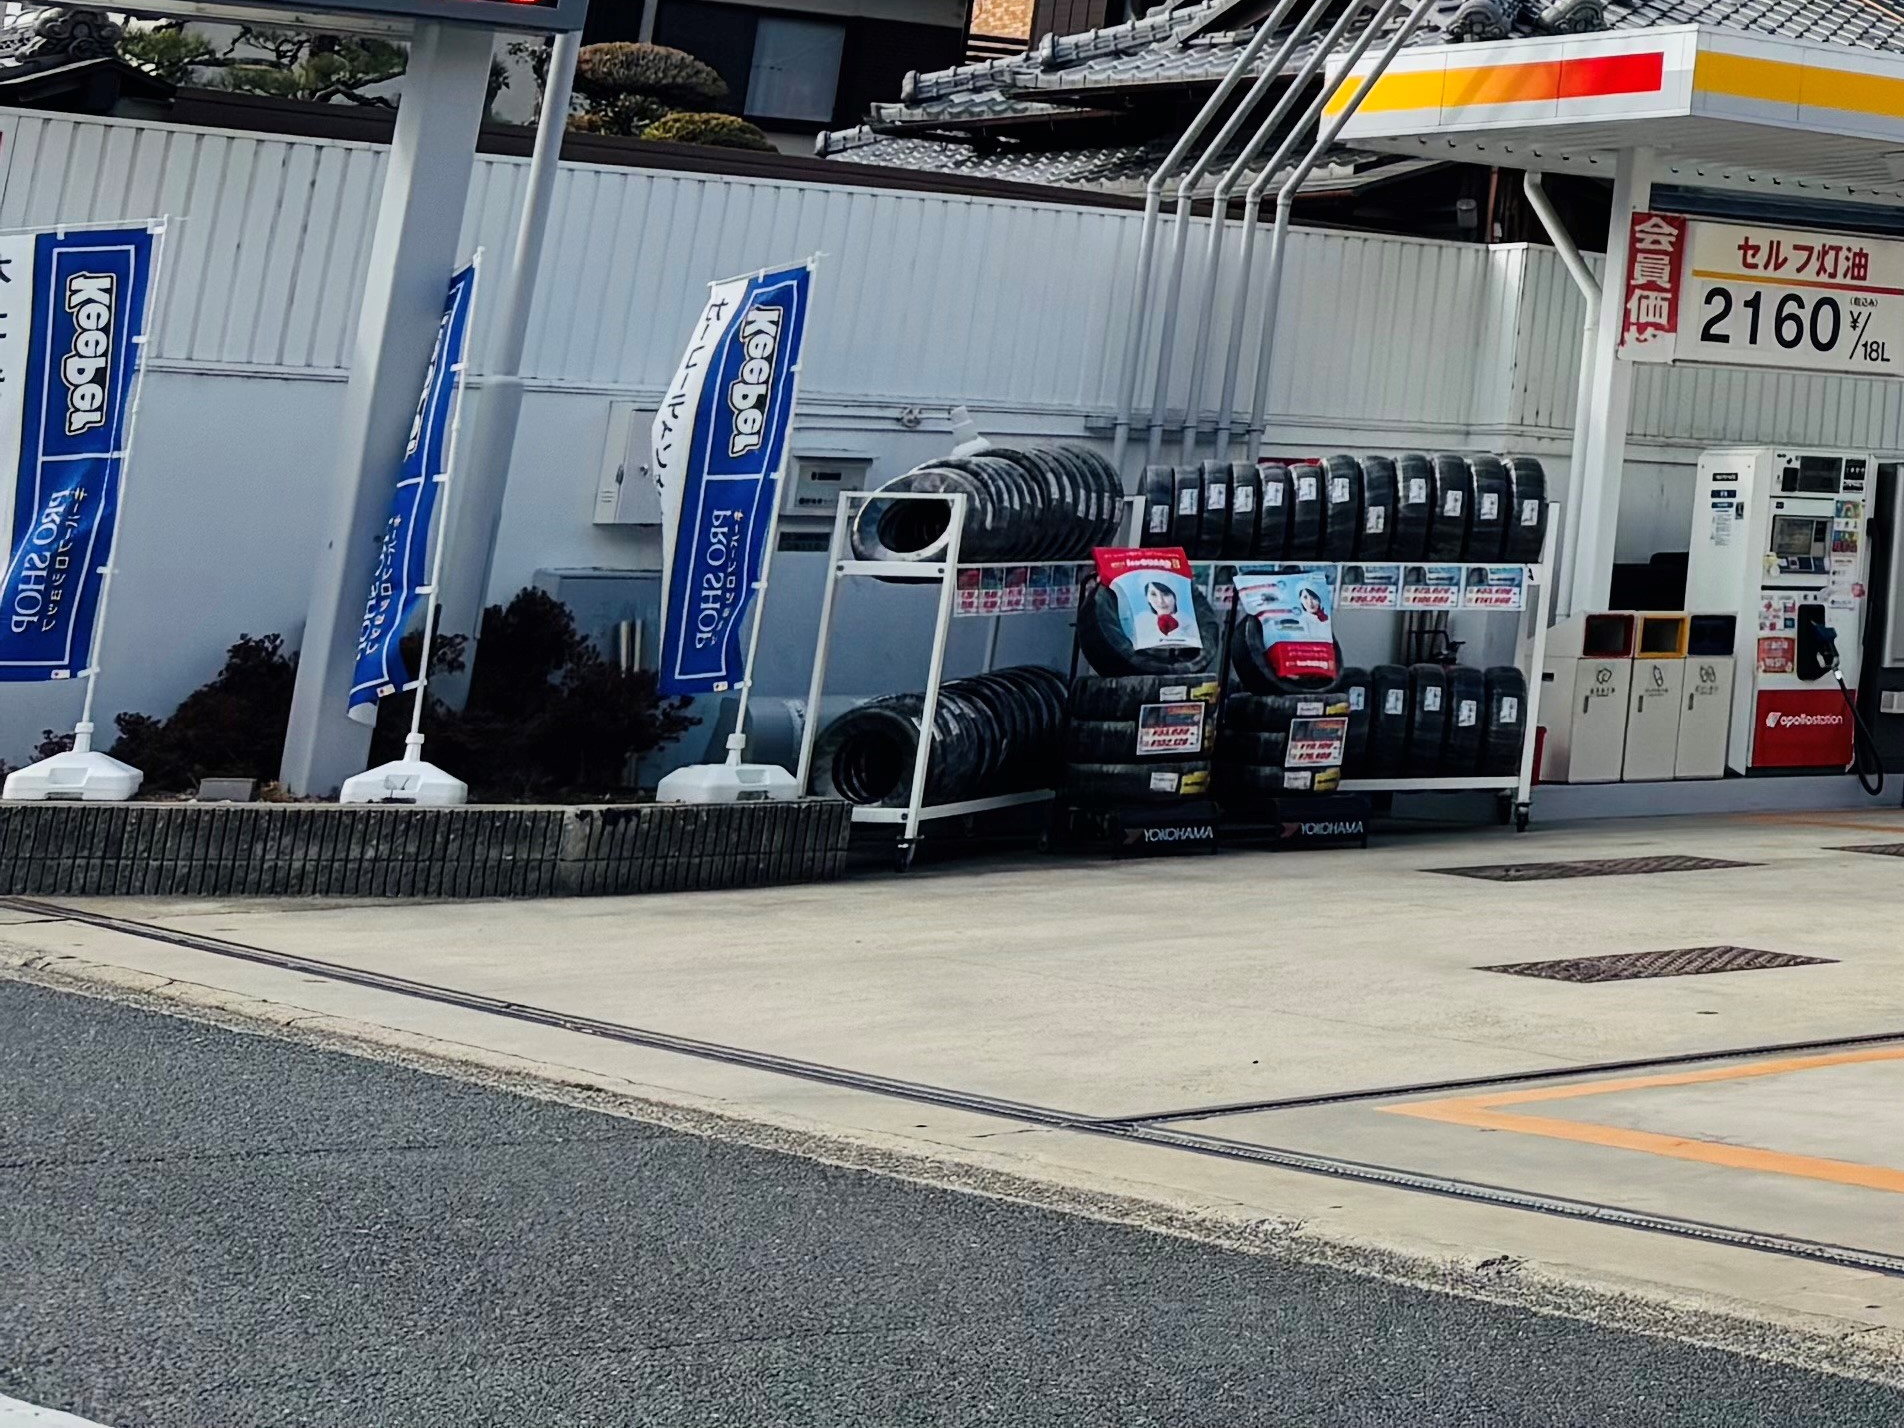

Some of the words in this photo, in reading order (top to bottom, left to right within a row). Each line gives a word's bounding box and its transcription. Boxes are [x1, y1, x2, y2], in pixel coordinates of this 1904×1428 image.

[1737, 236, 1869, 281] セルフ灯油
[1700, 287, 1841, 352] 2160
[1780, 712, 1843, 728] apollostation
[1144, 826, 1213, 843] YOKOHAMA
[1301, 821, 1363, 835] YOKOHAMA
